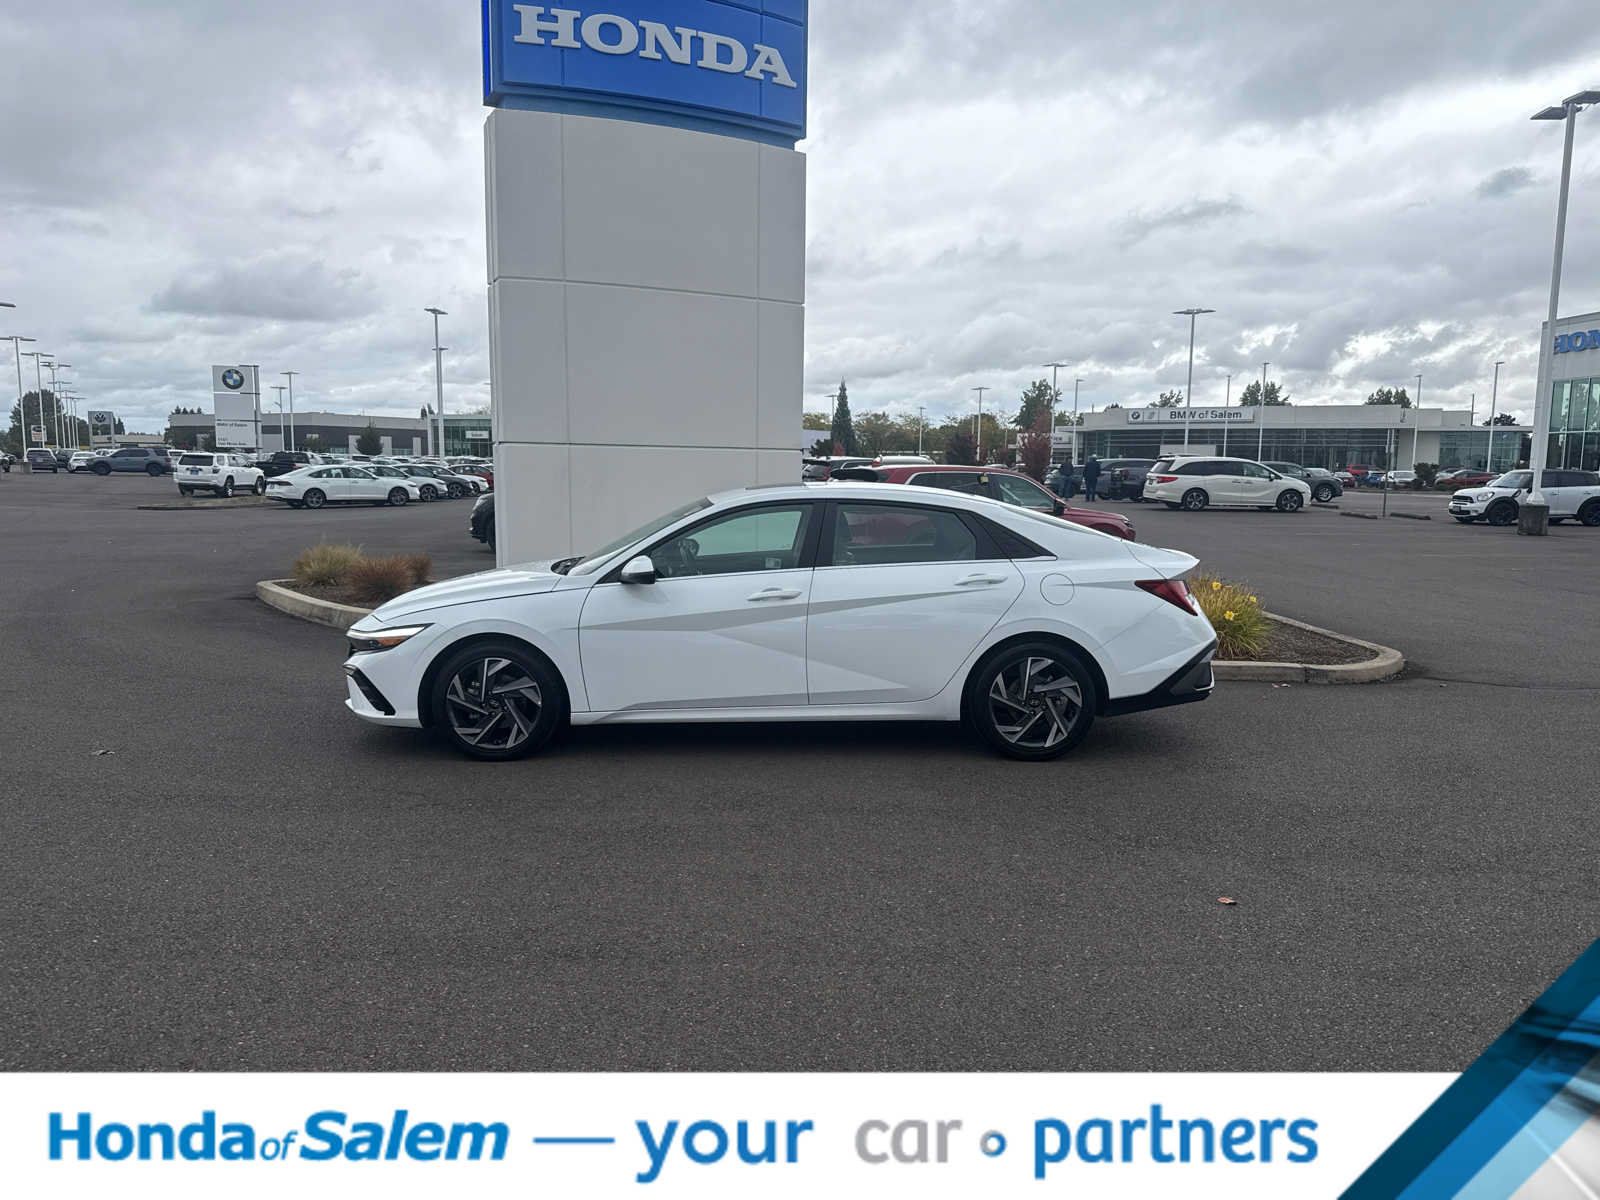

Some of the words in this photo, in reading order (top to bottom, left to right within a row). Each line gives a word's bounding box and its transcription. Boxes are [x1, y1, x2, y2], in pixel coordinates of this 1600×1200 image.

[512, 3, 798, 89] HONDA
[1169, 410, 1196, 420] BMW
[1198, 410, 1208, 419] of
[1210, 409, 1242, 419] Salem
